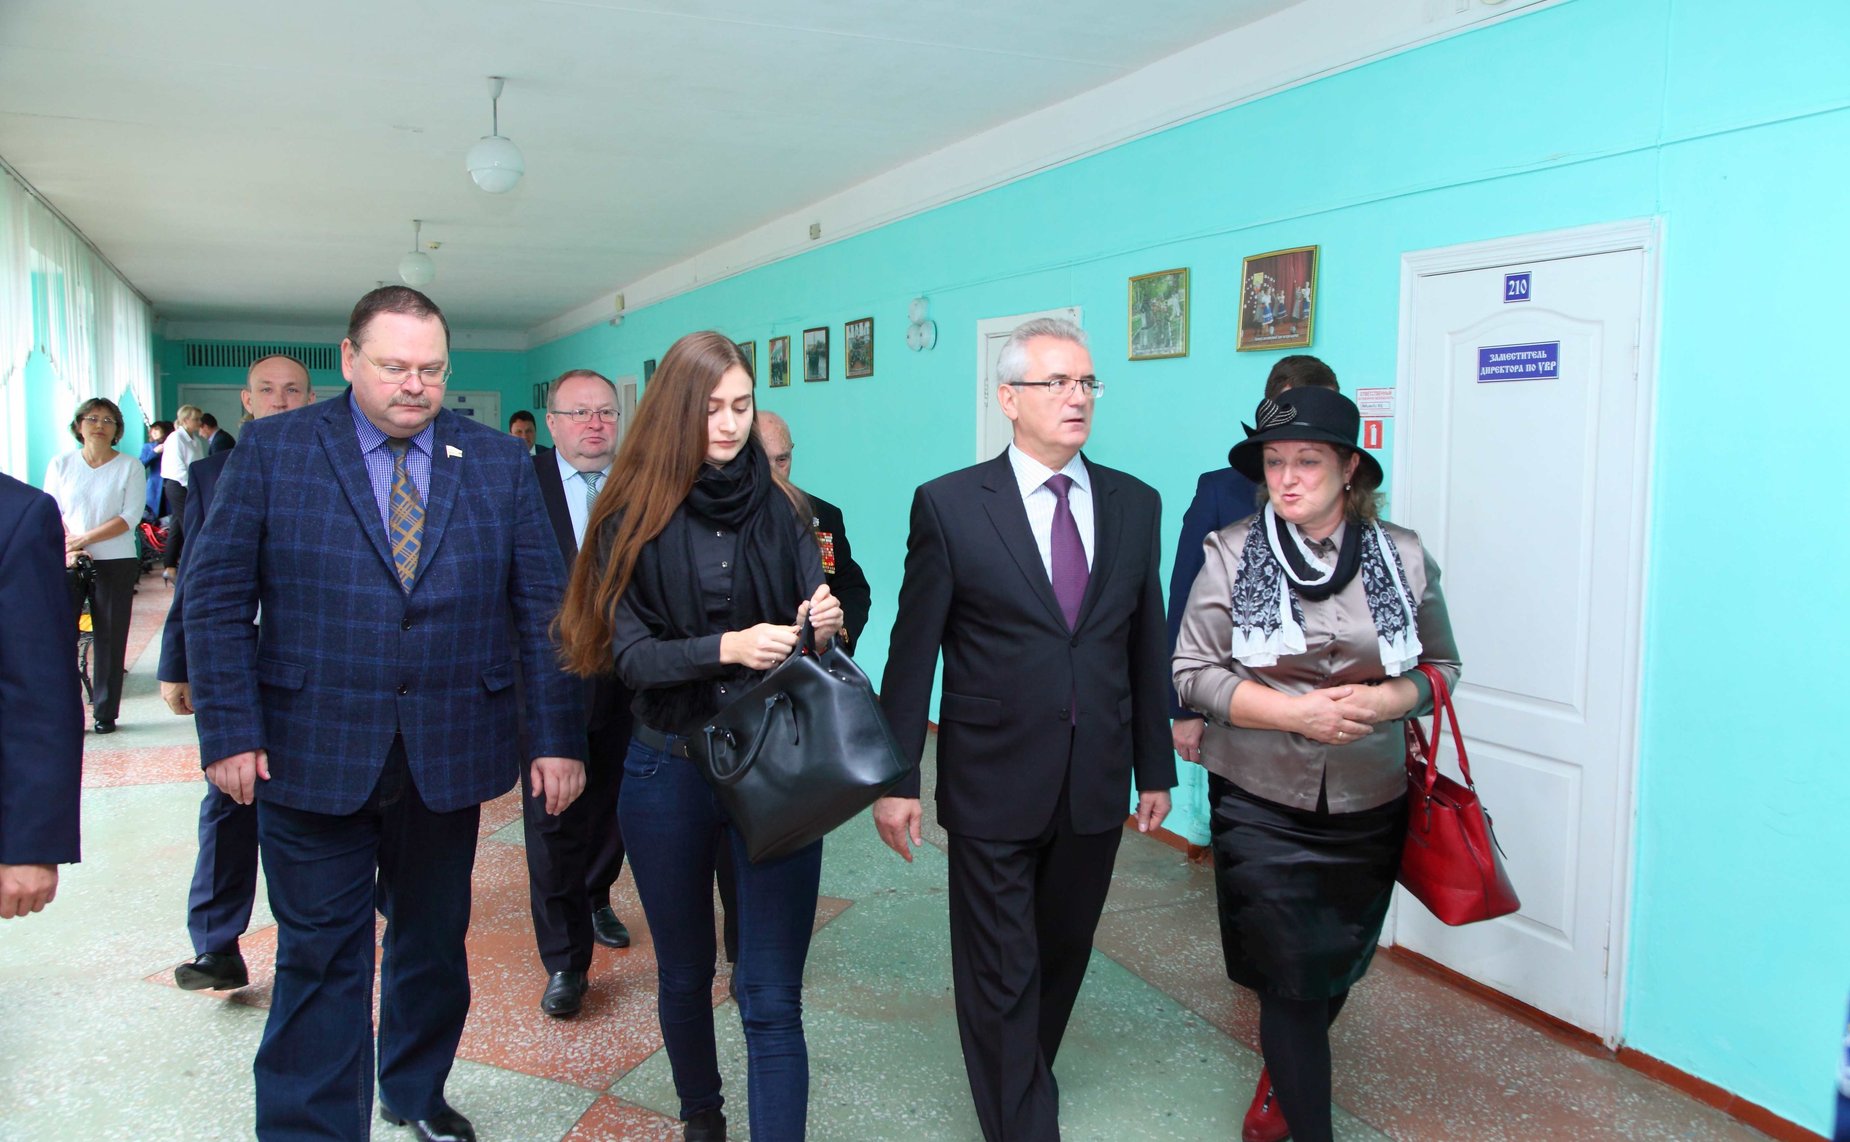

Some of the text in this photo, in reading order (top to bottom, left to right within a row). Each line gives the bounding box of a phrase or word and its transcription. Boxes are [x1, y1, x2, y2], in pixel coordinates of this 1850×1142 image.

[1509, 279, 1527, 295] 210
[1489, 350, 1547, 362] ЗАМЕСТИТЕЛЬ
[1480, 360, 1556, 376] ДИРЕКТОРА ПО УВР
